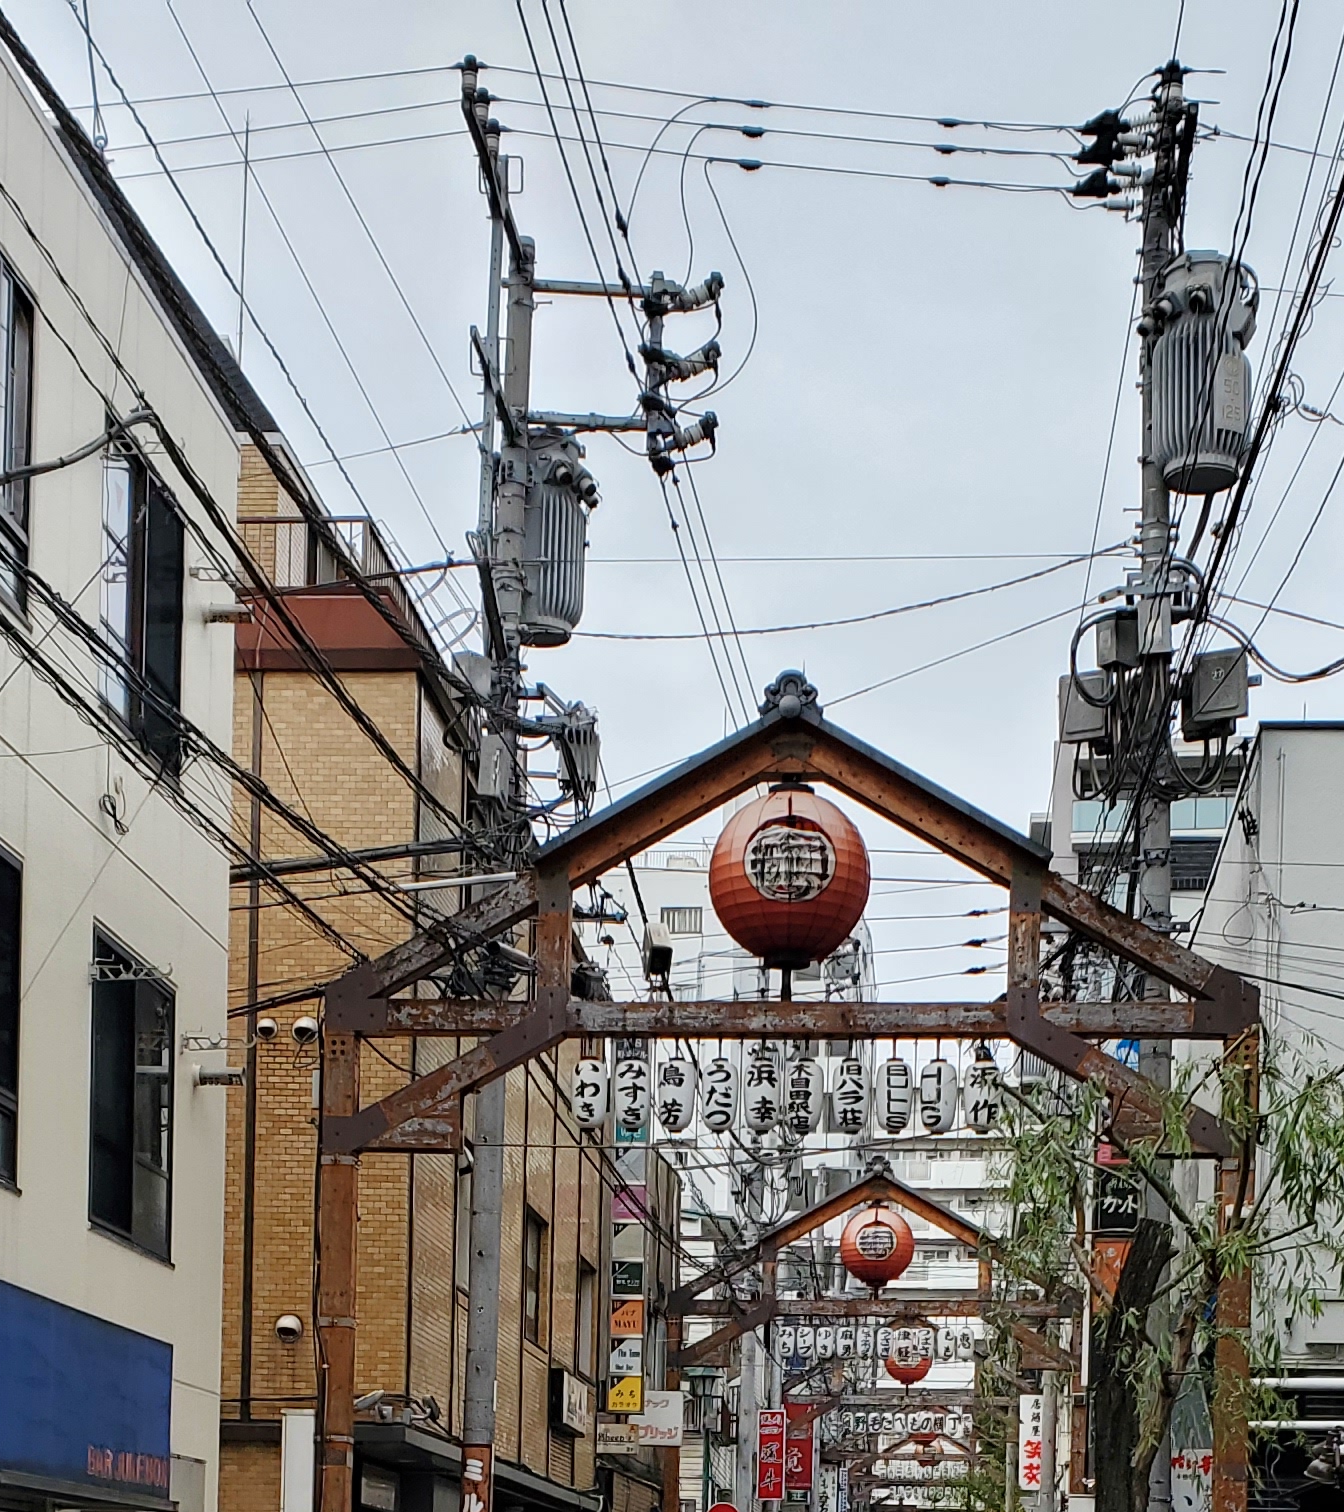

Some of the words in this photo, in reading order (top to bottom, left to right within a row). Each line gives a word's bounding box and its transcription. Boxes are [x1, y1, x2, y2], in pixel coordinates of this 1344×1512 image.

[574, 1062, 601, 1124] いわき
[705, 1064, 733, 1126] うだつ
[747, 1063, 779, 1123] 浜幸
[885, 1064, 908, 1130] BULLS
